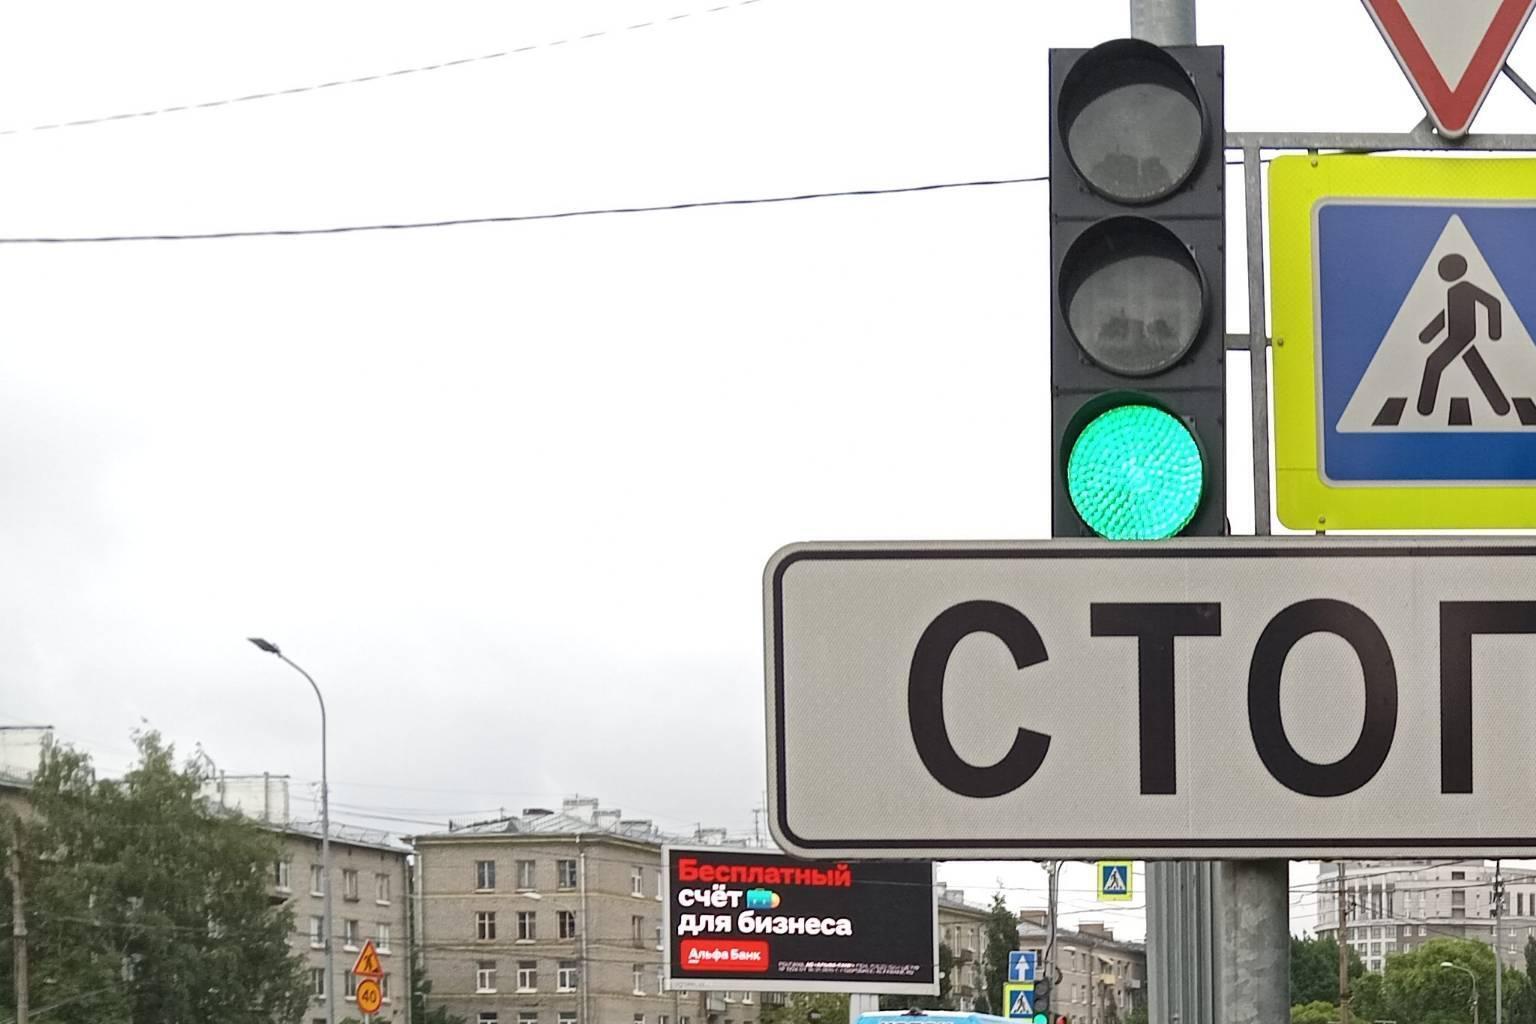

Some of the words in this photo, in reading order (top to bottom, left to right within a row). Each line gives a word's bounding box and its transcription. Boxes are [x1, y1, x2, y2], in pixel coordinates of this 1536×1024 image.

[677, 858, 852, 887] Бесплатный
[677, 884, 743, 908] счёт
[677, 914, 731, 936] для
[737, 911, 852, 936] бизнеса
[688, 948, 729, 963] Альфа
[730, 949, 761, 961] Банк
[361, 990, 377, 1003] 40
